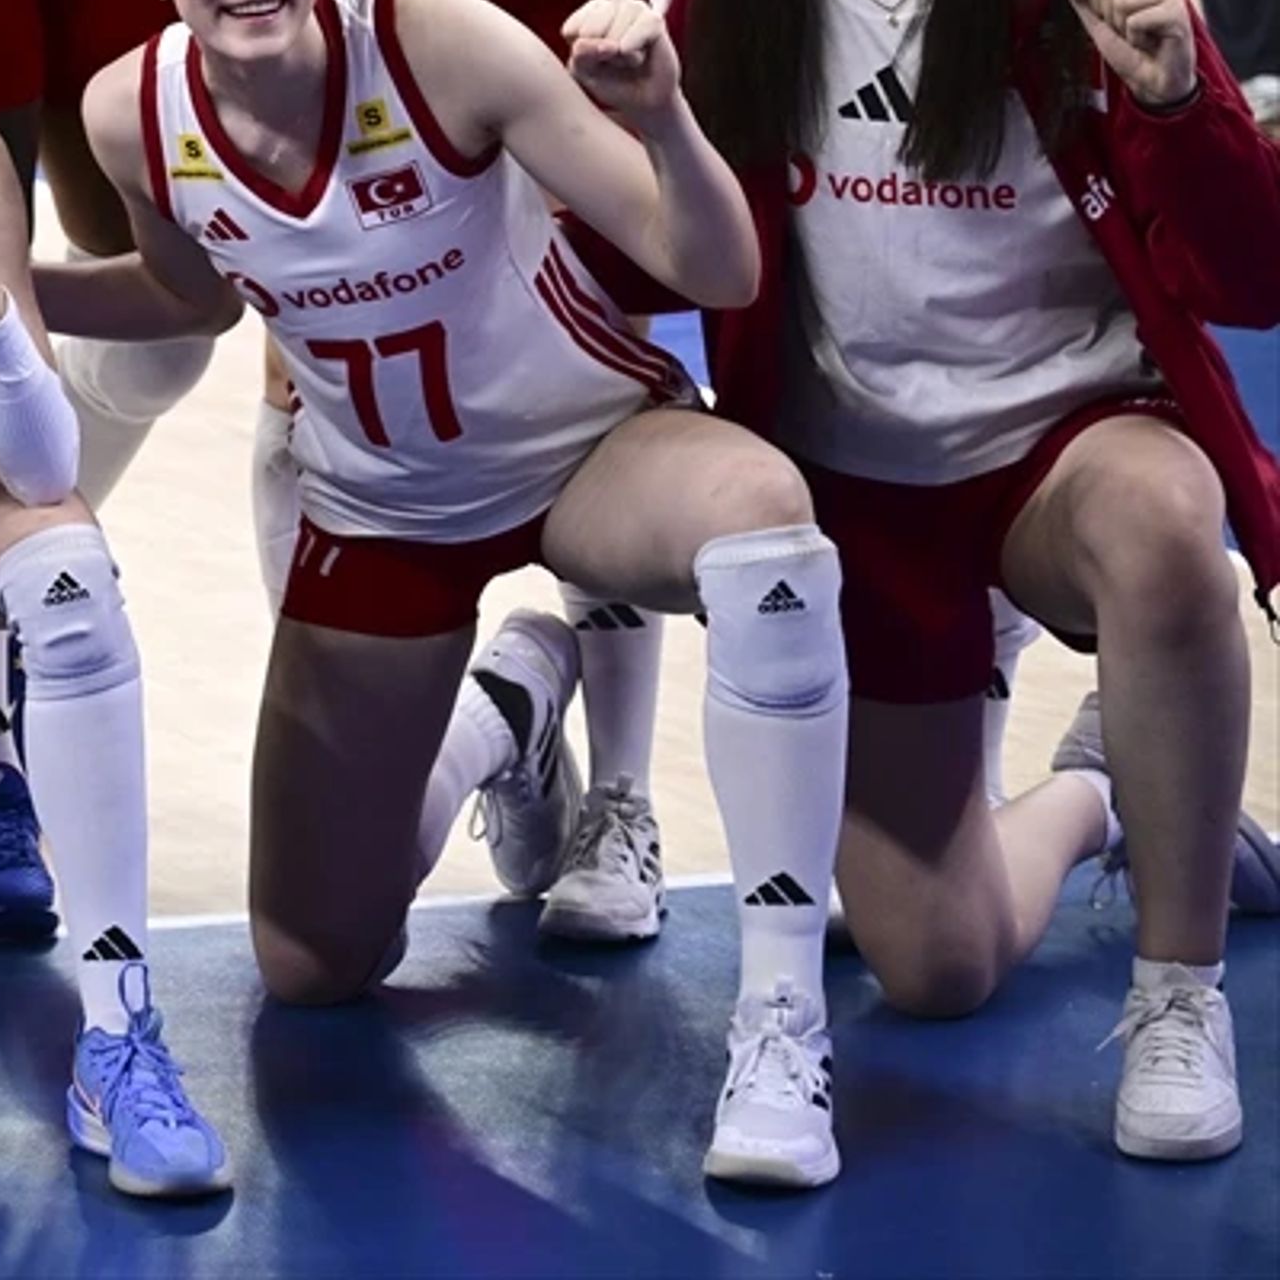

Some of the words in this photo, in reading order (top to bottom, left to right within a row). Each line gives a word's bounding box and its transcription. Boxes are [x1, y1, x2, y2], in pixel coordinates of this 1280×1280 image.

[363, 106, 382, 127] S
[184, 140, 202, 159] S
[828, 171, 1017, 210] vodafone
[377, 204, 415, 222] TUR
[282, 247, 465, 310] vodafone
[305, 319, 464, 450] 77
